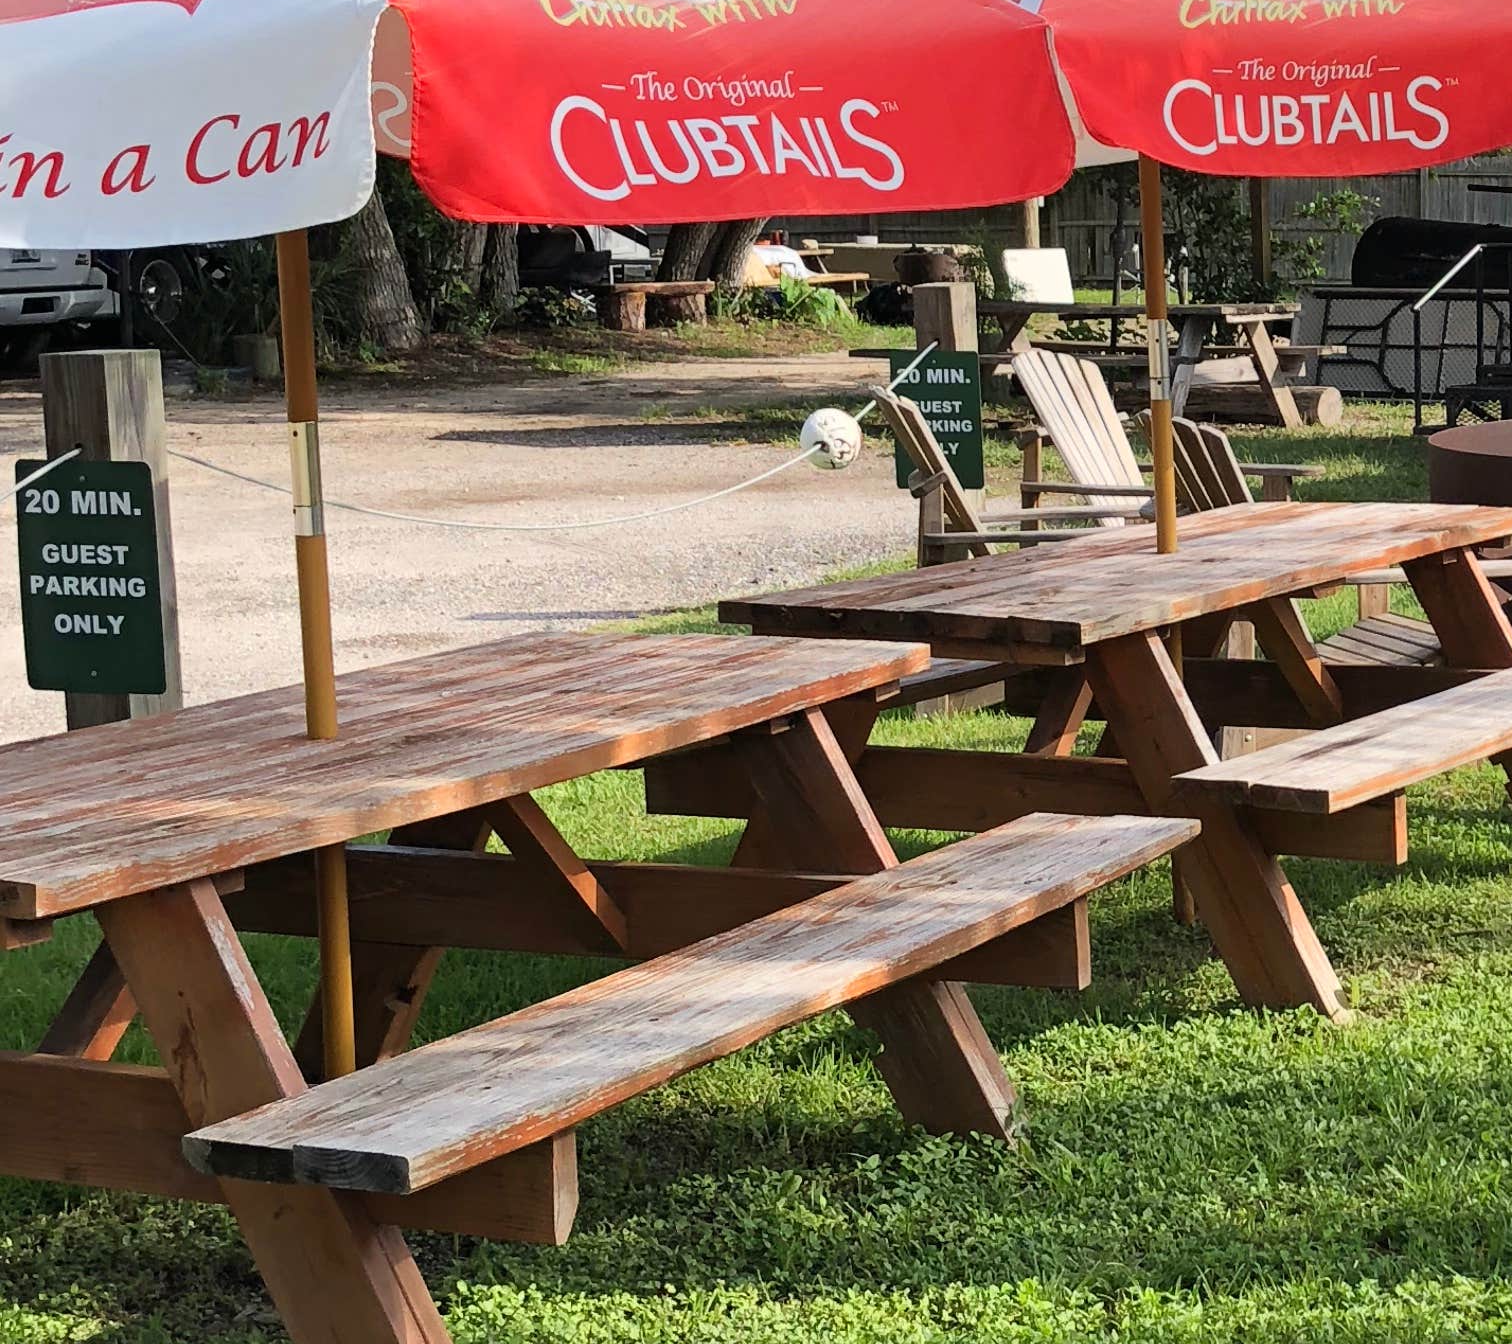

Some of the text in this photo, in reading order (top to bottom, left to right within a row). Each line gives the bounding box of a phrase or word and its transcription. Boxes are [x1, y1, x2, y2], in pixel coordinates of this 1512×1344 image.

[1237, 55, 1378, 88] The Original
[630, 70, 796, 107] The Original
[1162, 75, 1450, 157] CLUBTAILS
[100, 143, 157, 197] a
[185, 110, 332, 186] Can
[550, 94, 905, 202] CLUBTAILS
[896, 368, 972, 385] 20 MIN.
[915, 400, 963, 414] UEST
[928, 419, 974, 433] KING
[24, 489, 142, 517] 20 MIN.
[42, 543, 129, 566] GUEST
[30, 575, 146, 599] PARKING
[54, 613, 125, 636] ONLY
